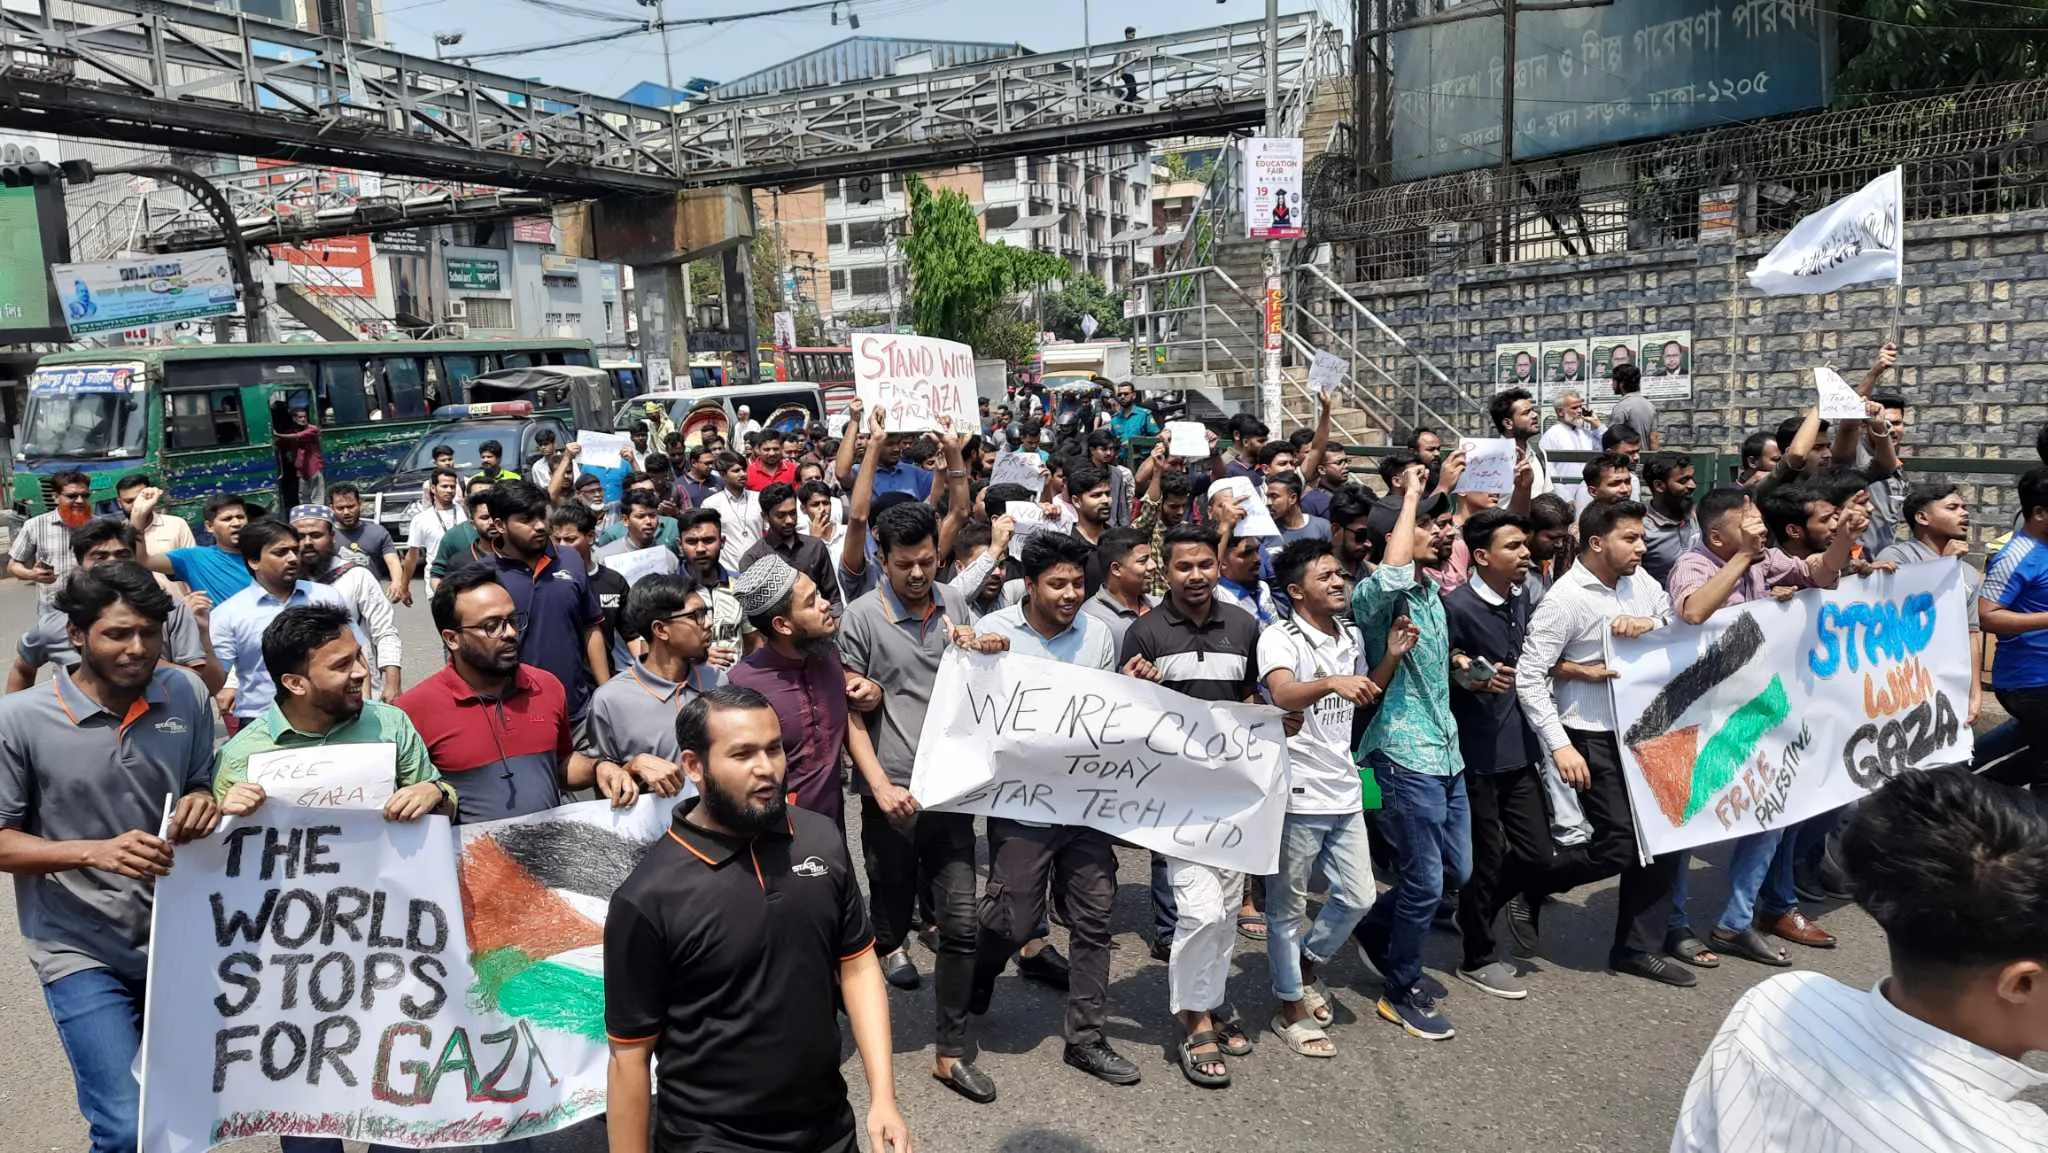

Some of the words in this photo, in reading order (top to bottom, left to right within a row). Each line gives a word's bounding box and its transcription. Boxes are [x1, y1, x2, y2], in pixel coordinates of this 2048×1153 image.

[1557, 49, 1574, 79] ও
[1633, 7, 1722, 61] গবেষণা
[1256, 160, 1297, 168] EDUCATION
[1256, 186, 1269, 196] 19
[1267, 167, 1284, 175] FAIR
[861, 336, 934, 380] STAND
[939, 347, 974, 379] WITH
[471, 404, 489, 412] POLICE
[1807, 591, 1937, 680] STAND
[966, 680, 1051, 735] WE
[1055, 693, 1132, 750] ARE
[1145, 711, 1266, 762] CLOSE
[1843, 689, 1958, 790] GAZA
[257, 754, 334, 785] FREE
[296, 786, 364, 808] GAZA
[1064, 754, 1163, 788] TODAY
[1714, 750, 1776, 831] FREE
[1754, 718, 1813, 829] PALESTINE
[957, 780, 1057, 815] STAR
[1077, 788, 1166, 829] TECH
[1173, 808, 1243, 848] LTD
[223, 825, 342, 881] THE
[209, 886, 449, 954] WORLD
[214, 951, 449, 1020] STOPS
[212, 1015, 362, 1094] FOR
[372, 1018, 559, 1107] GAZA
